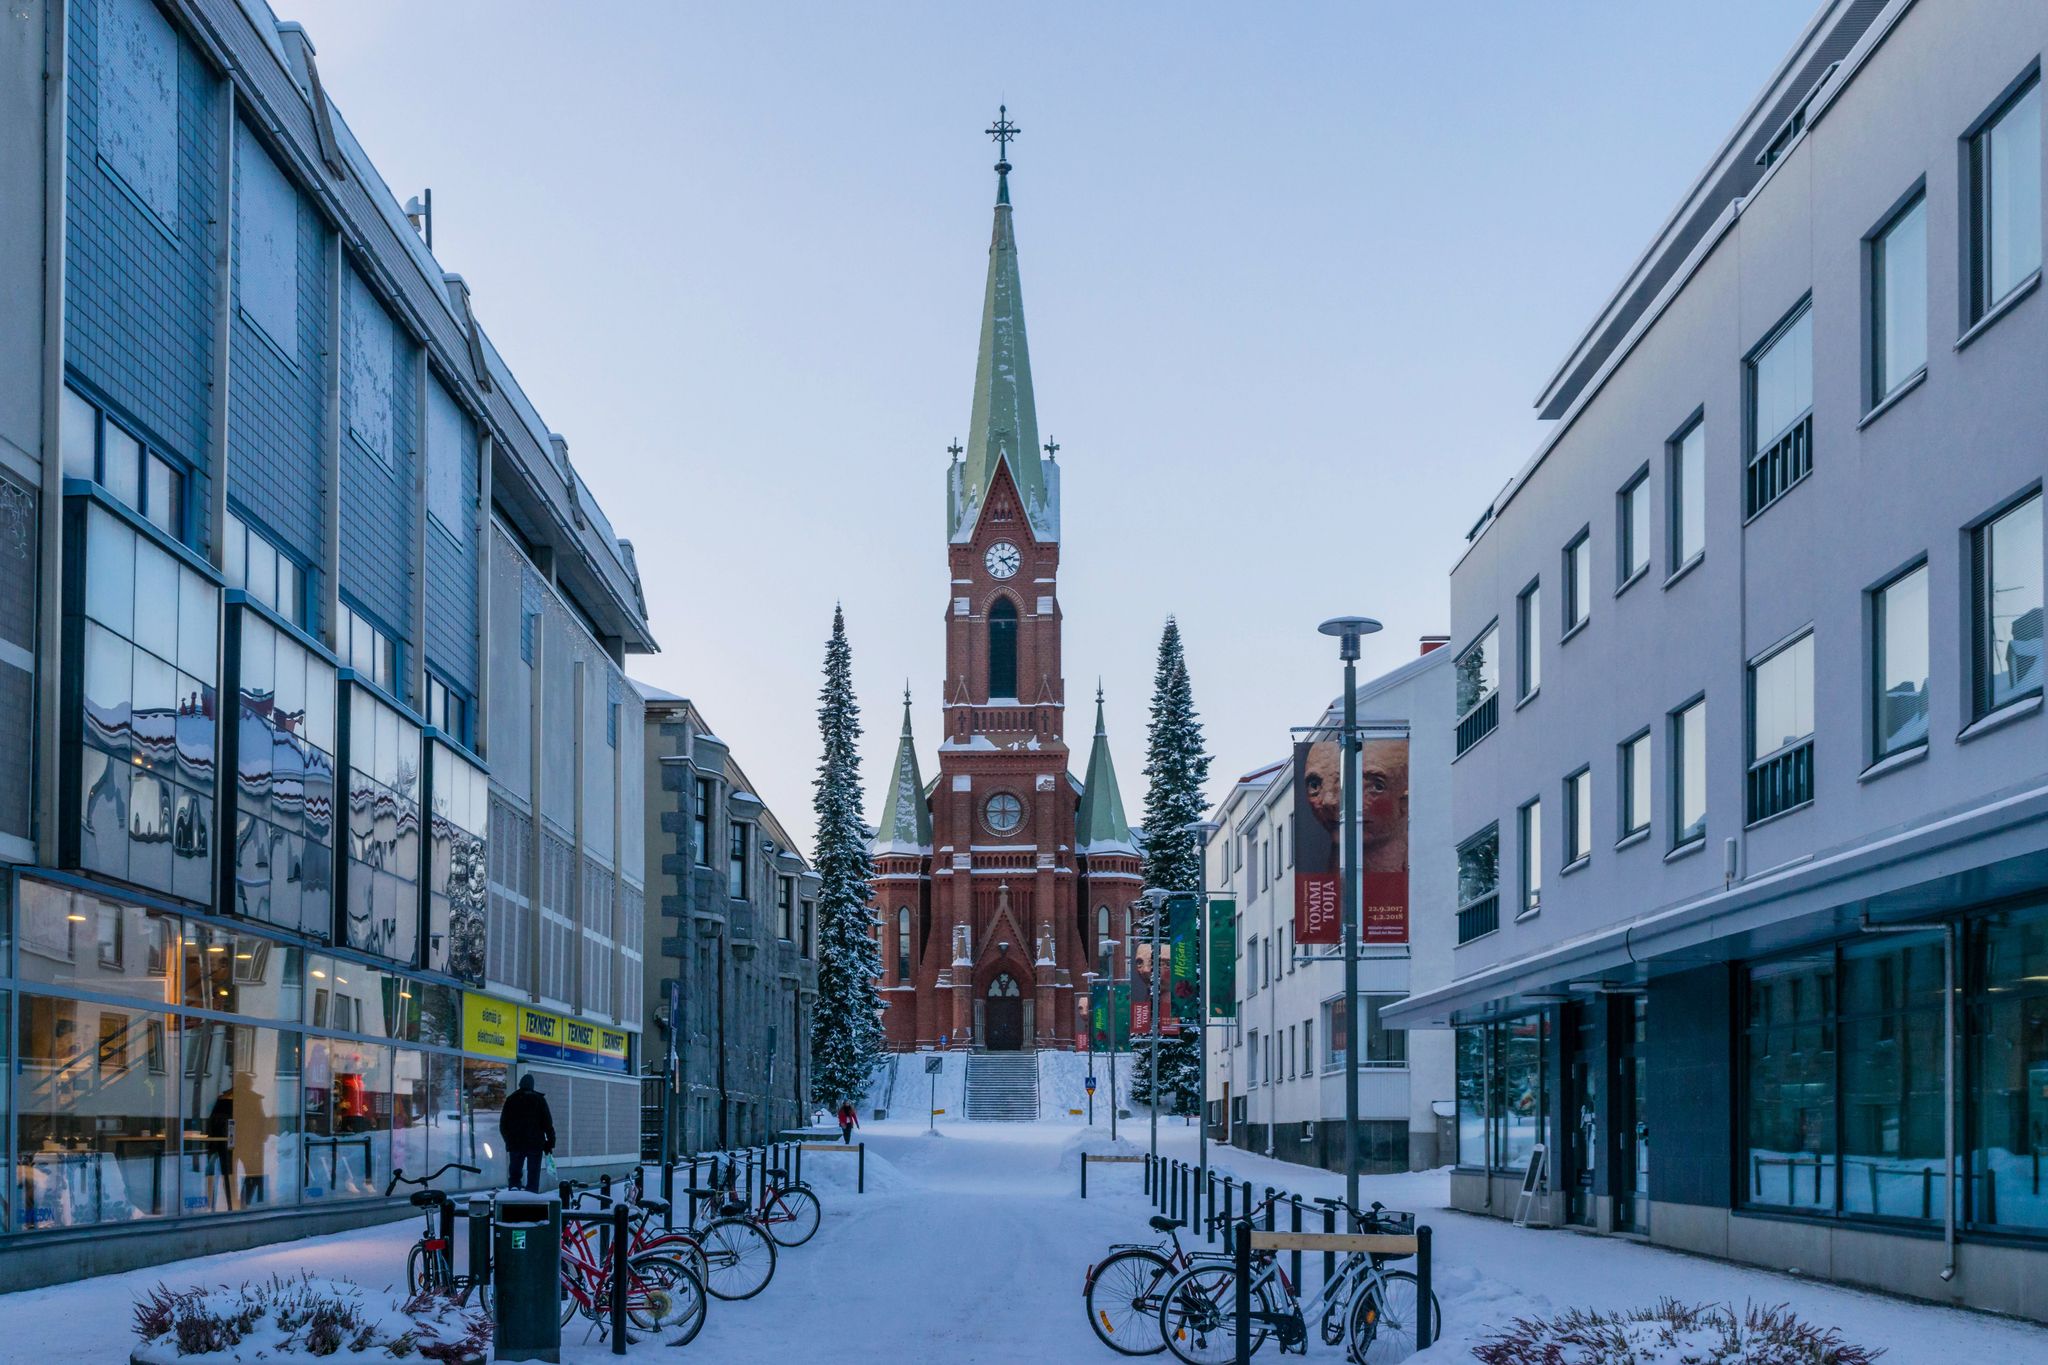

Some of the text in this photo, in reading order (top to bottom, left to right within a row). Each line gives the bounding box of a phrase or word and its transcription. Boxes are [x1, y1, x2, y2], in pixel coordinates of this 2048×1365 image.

[1309, 881, 1321, 934] TOMMI
[1322, 881, 1337, 922] TOIJA
[526, 1012, 556, 1037] TEKNISET
[568, 1023, 594, 1045] TEKNISET
[602, 1031, 624, 1052] TEKNISET
